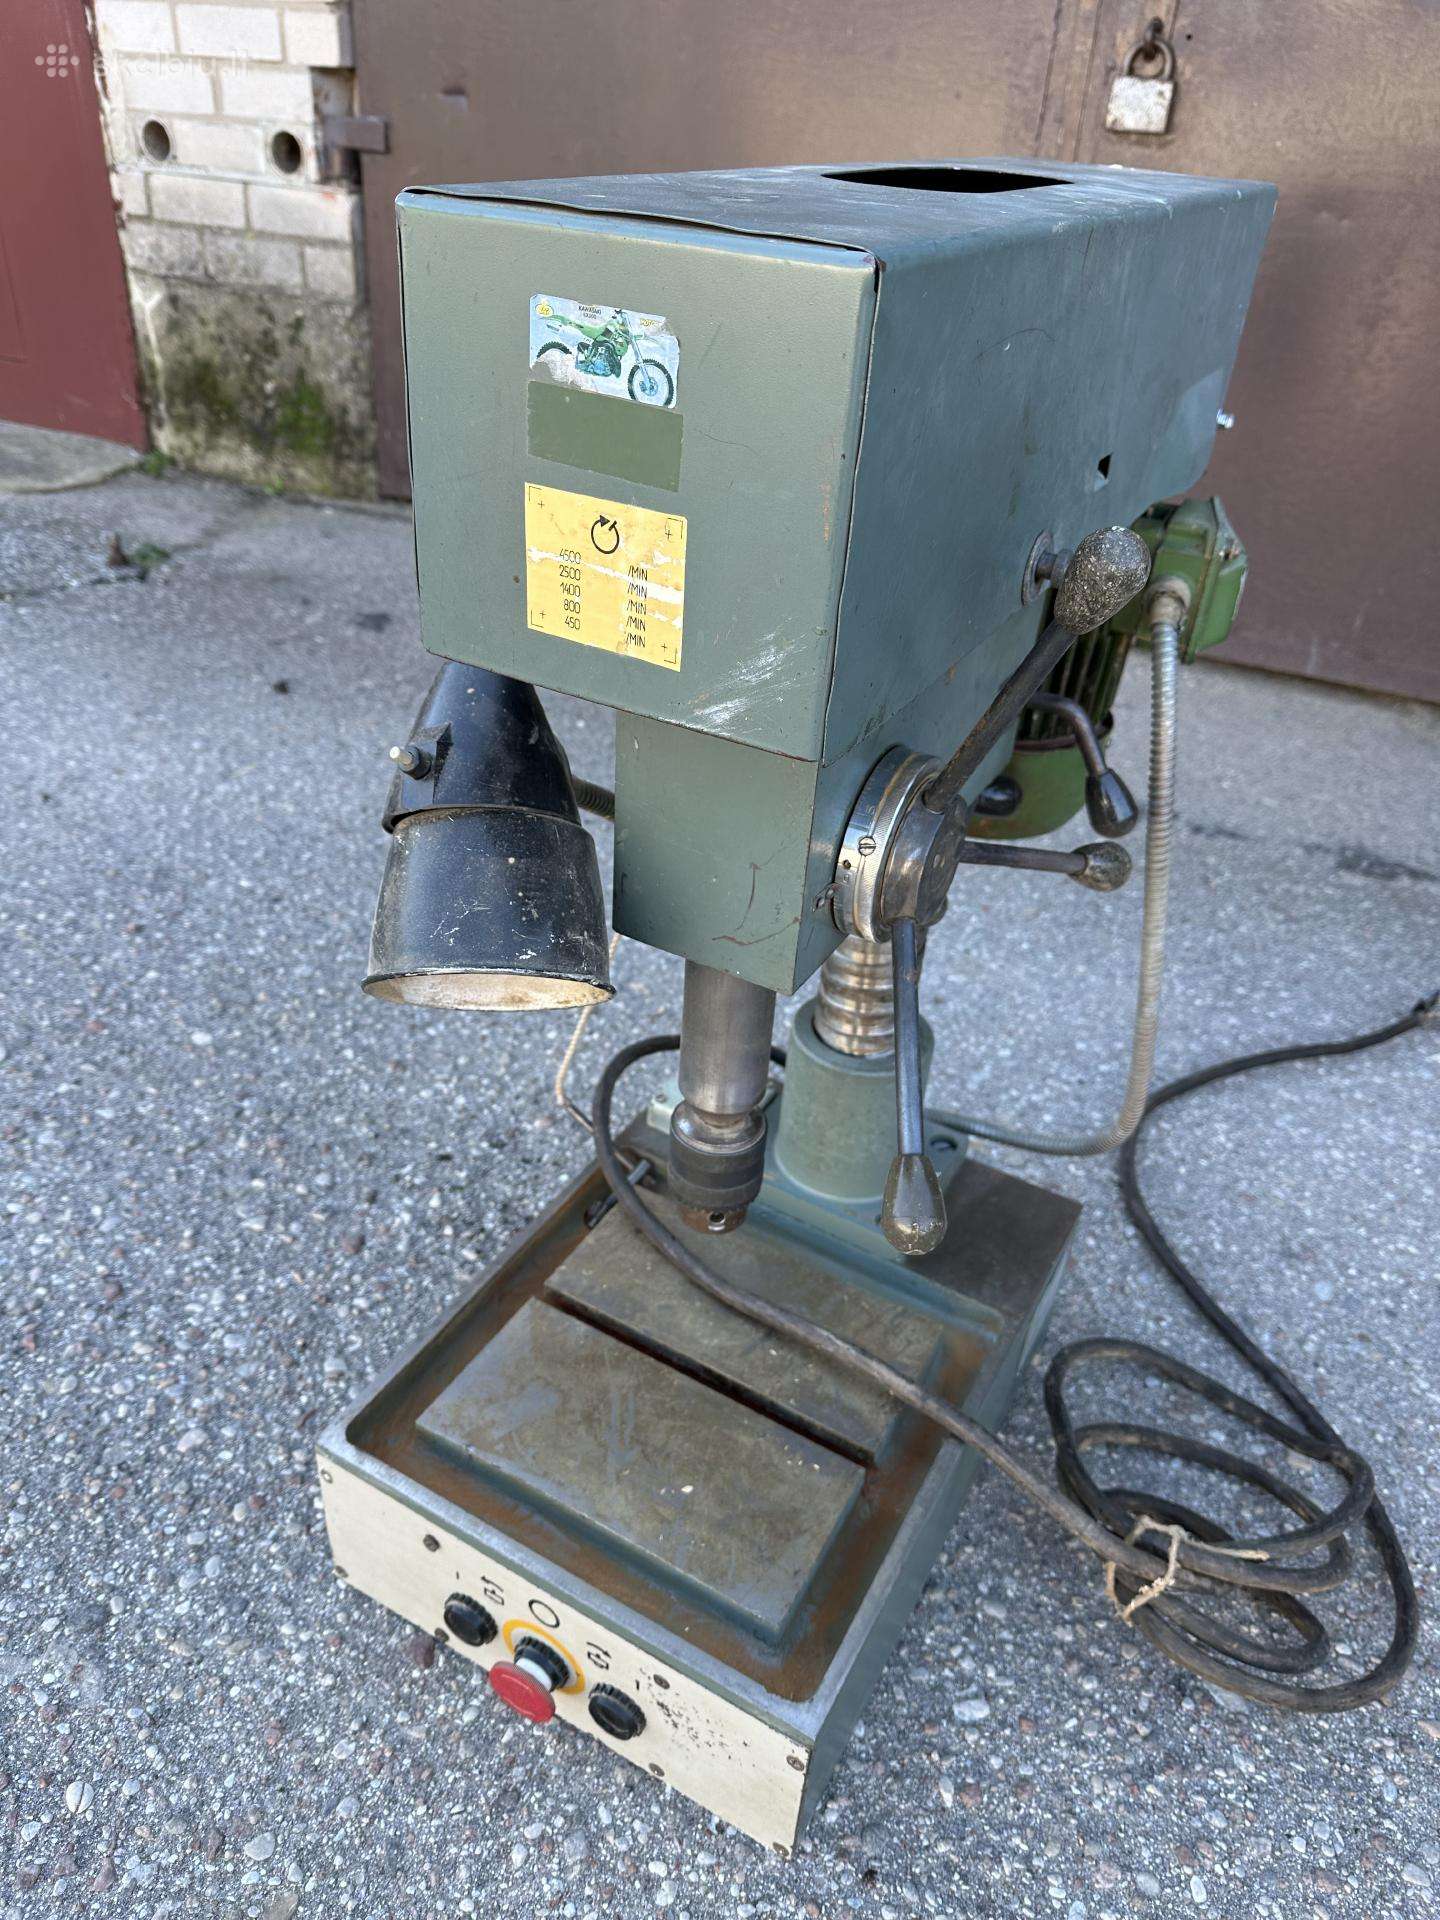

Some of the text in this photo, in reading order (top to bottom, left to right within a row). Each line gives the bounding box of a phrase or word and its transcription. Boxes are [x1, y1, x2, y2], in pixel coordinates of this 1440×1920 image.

[559, 548, 648, 581] 4500 /MIN
[559, 565, 647, 599] 2500 /MIN
[560, 582, 647, 615] 1400 /MIN
[564, 598, 646, 632] 800 /MIN
[565, 615, 646, 648] 450 /MIN
